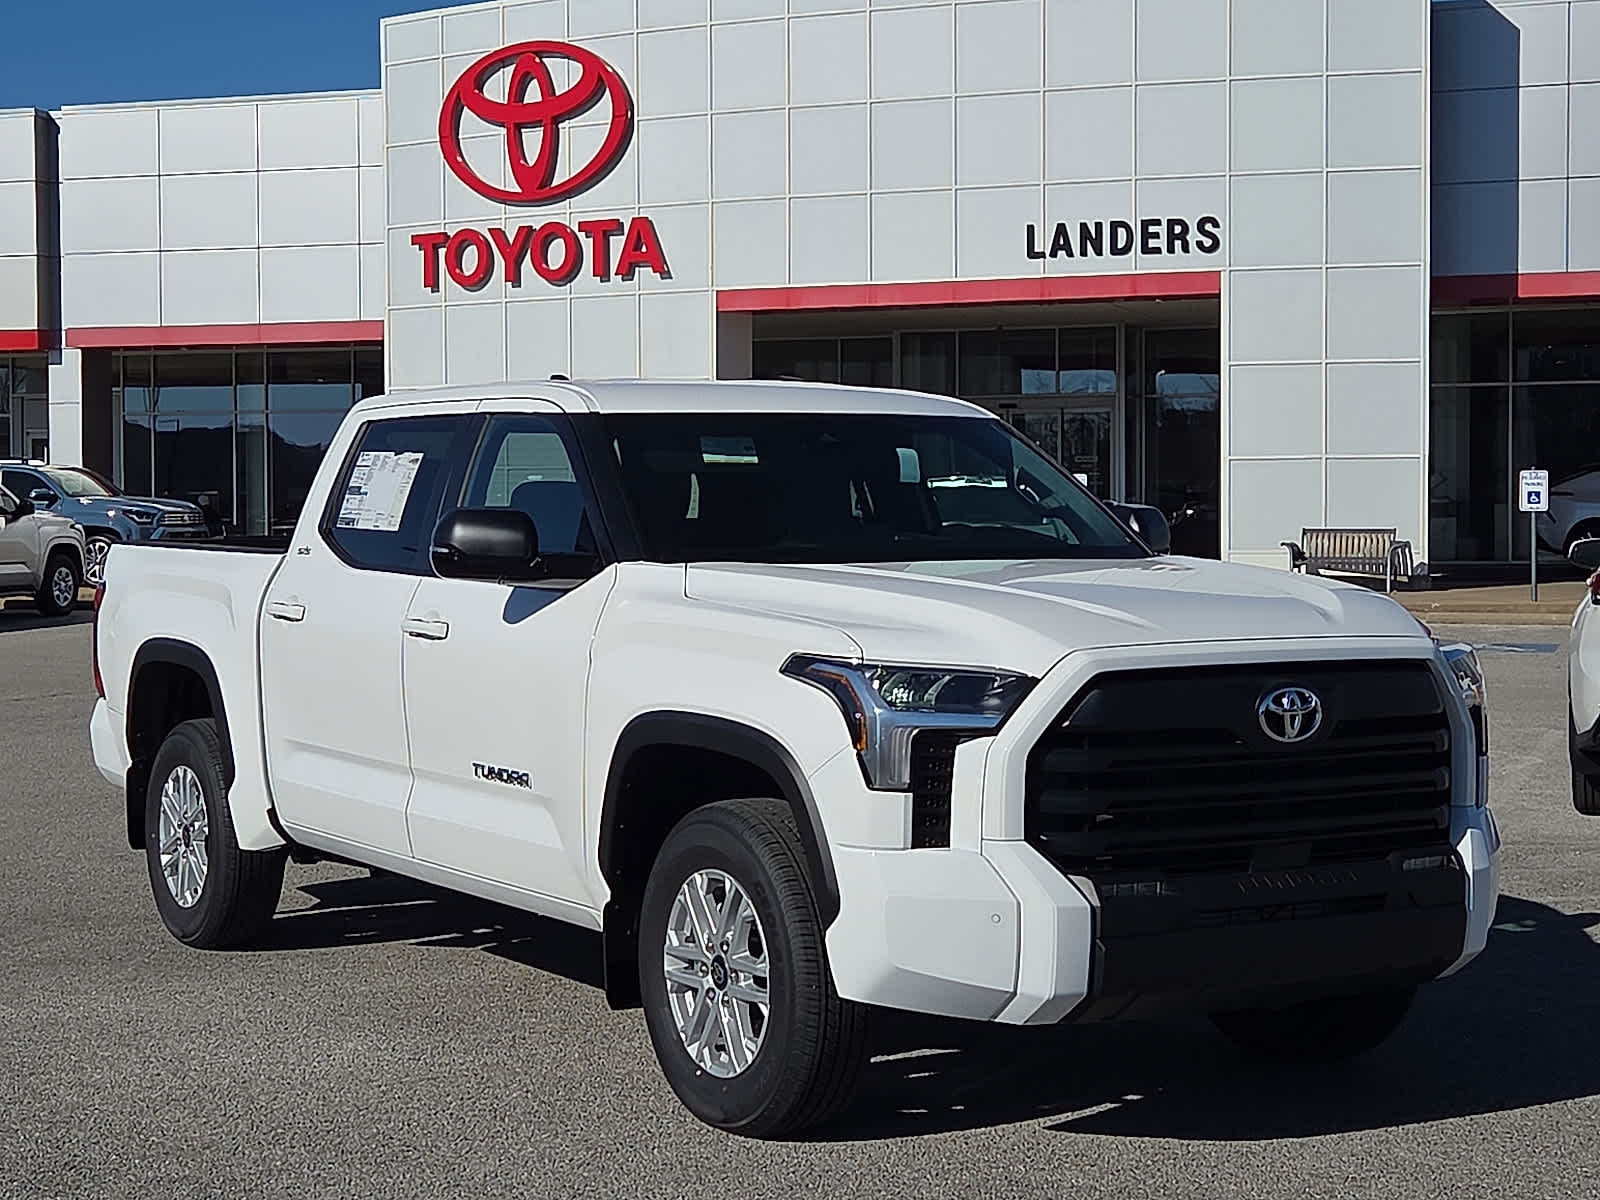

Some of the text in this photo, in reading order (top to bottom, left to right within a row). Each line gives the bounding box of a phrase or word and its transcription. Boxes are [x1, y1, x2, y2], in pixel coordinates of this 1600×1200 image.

[411, 216, 672, 292] TOYOTA
[1026, 216, 1221, 260] LANDERS
[472, 762, 533, 790] TUNDRA
